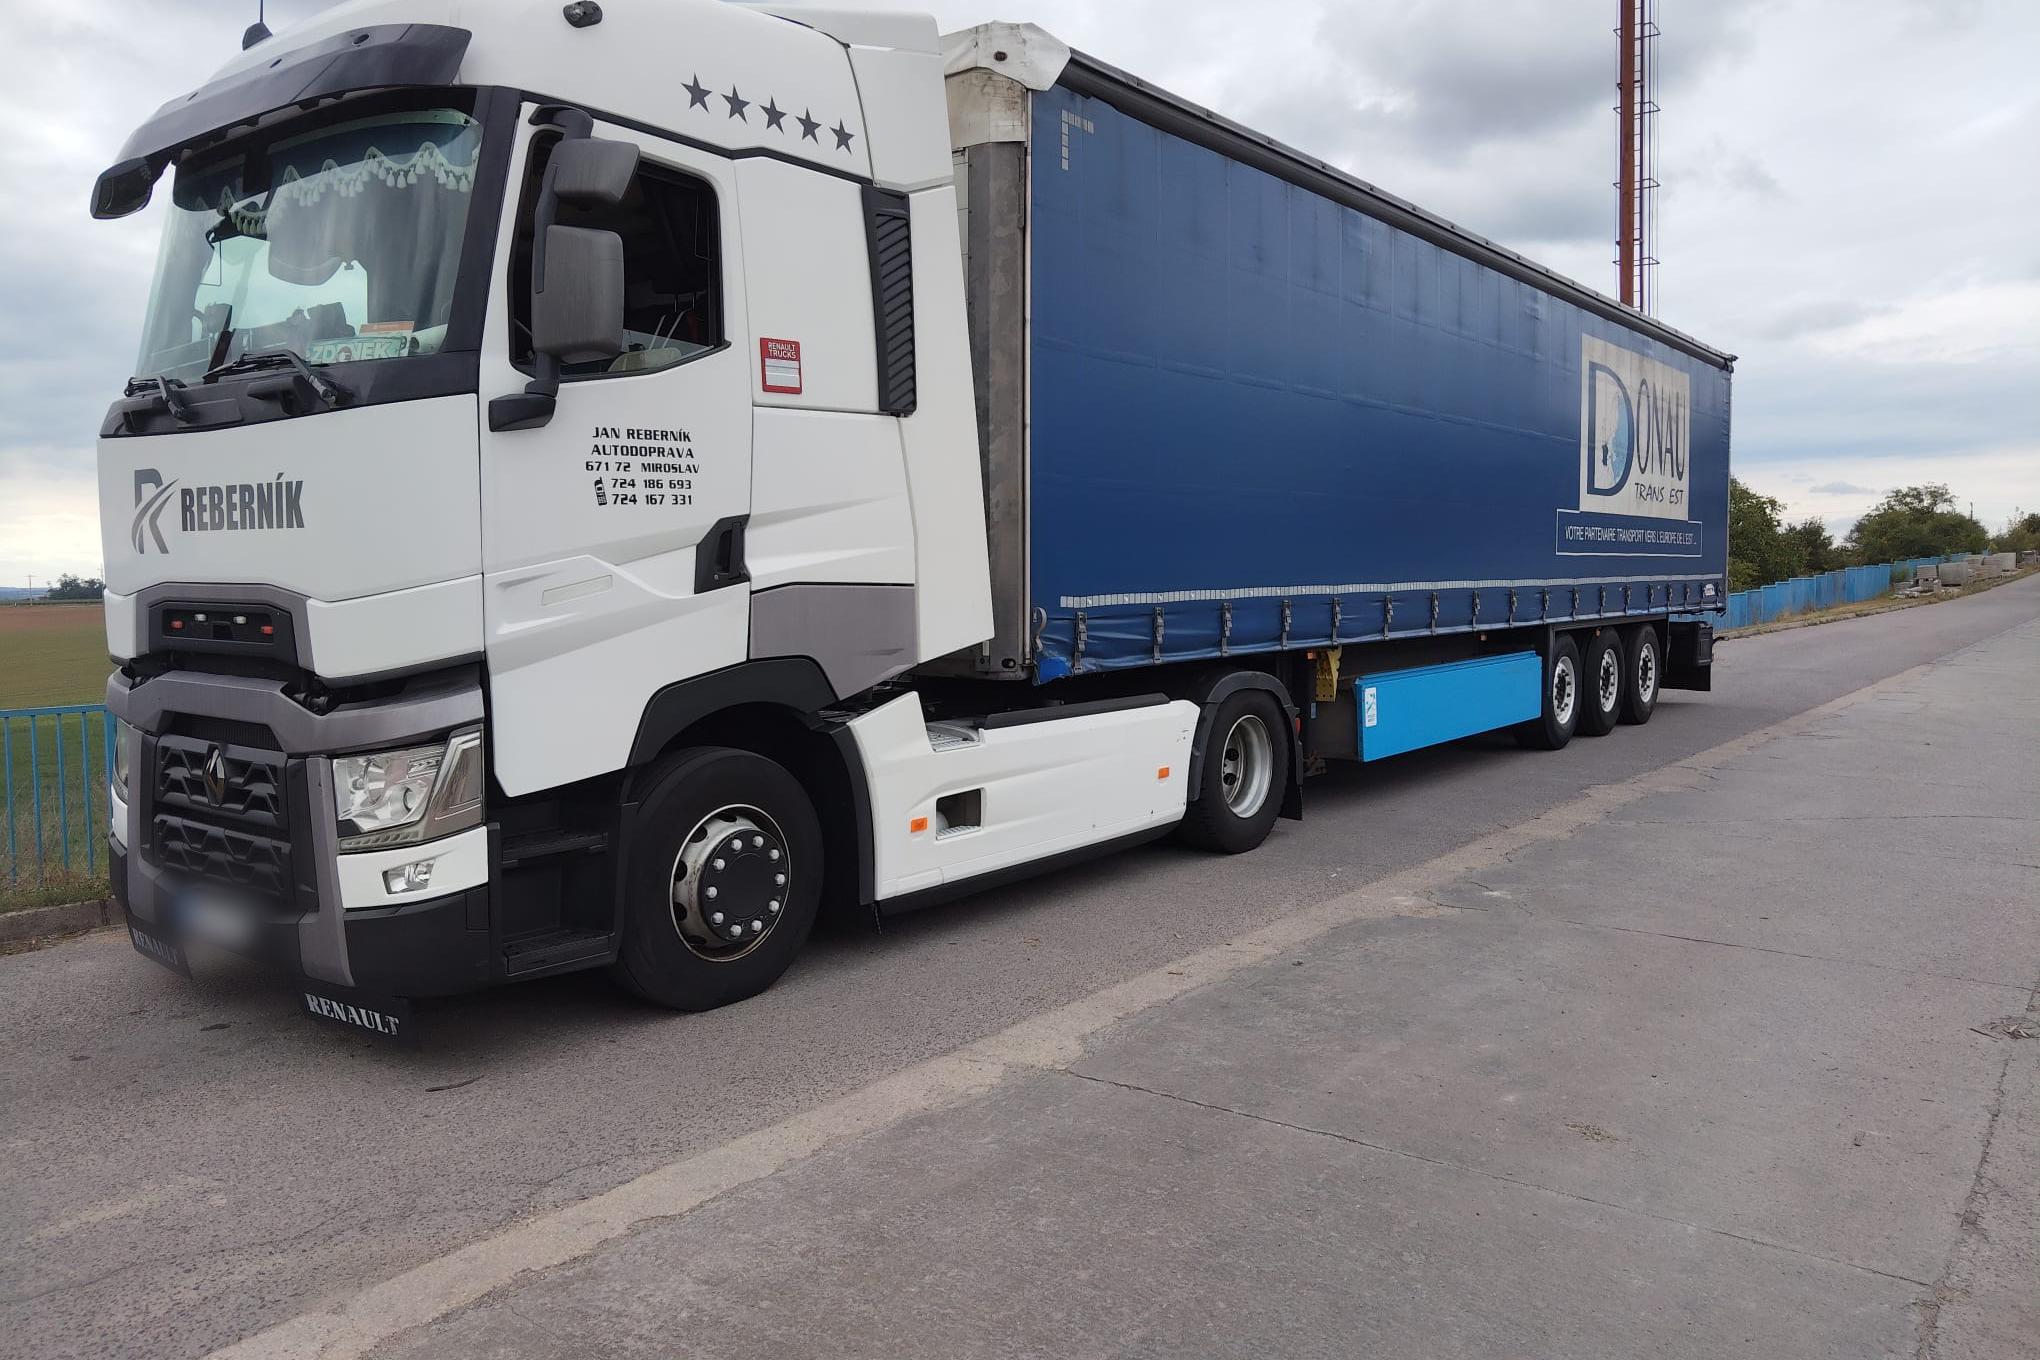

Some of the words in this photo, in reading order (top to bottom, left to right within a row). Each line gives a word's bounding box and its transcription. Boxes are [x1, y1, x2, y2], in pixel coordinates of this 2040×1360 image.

[768, 341, 796, 351] RENAULT
[769, 349, 797, 359] TRUCKS
[592, 427, 620, 439] JAN
[626, 428, 692, 442] REBERNÍK
[1587, 360, 1687, 497] DONAU
[591, 444, 694, 459] AUTODOPRAVA
[585, 461, 609, 472] 671
[615, 461, 631, 472] 72
[641, 462, 700, 474] MIROSLAV
[611, 478, 636, 489] 724
[643, 479, 664, 489] 186
[669, 479, 692, 490] 693
[611, 493, 638, 505] 724
[645, 494, 665, 505] 167
[671, 494, 692, 505] 331
[1634, 482, 1665, 503] TRANS
[1669, 488, 1684, 505] EST
[181, 472, 305, 532] REBERNÍK
[1565, 526, 1584, 540] VOTRE
[1585, 527, 1616, 541] PARTENAIRE
[1617, 528, 1645, 543] TRANSPORT
[1644, 530, 1657, 543] VERS
[304, 992, 400, 1036] RENAULT
